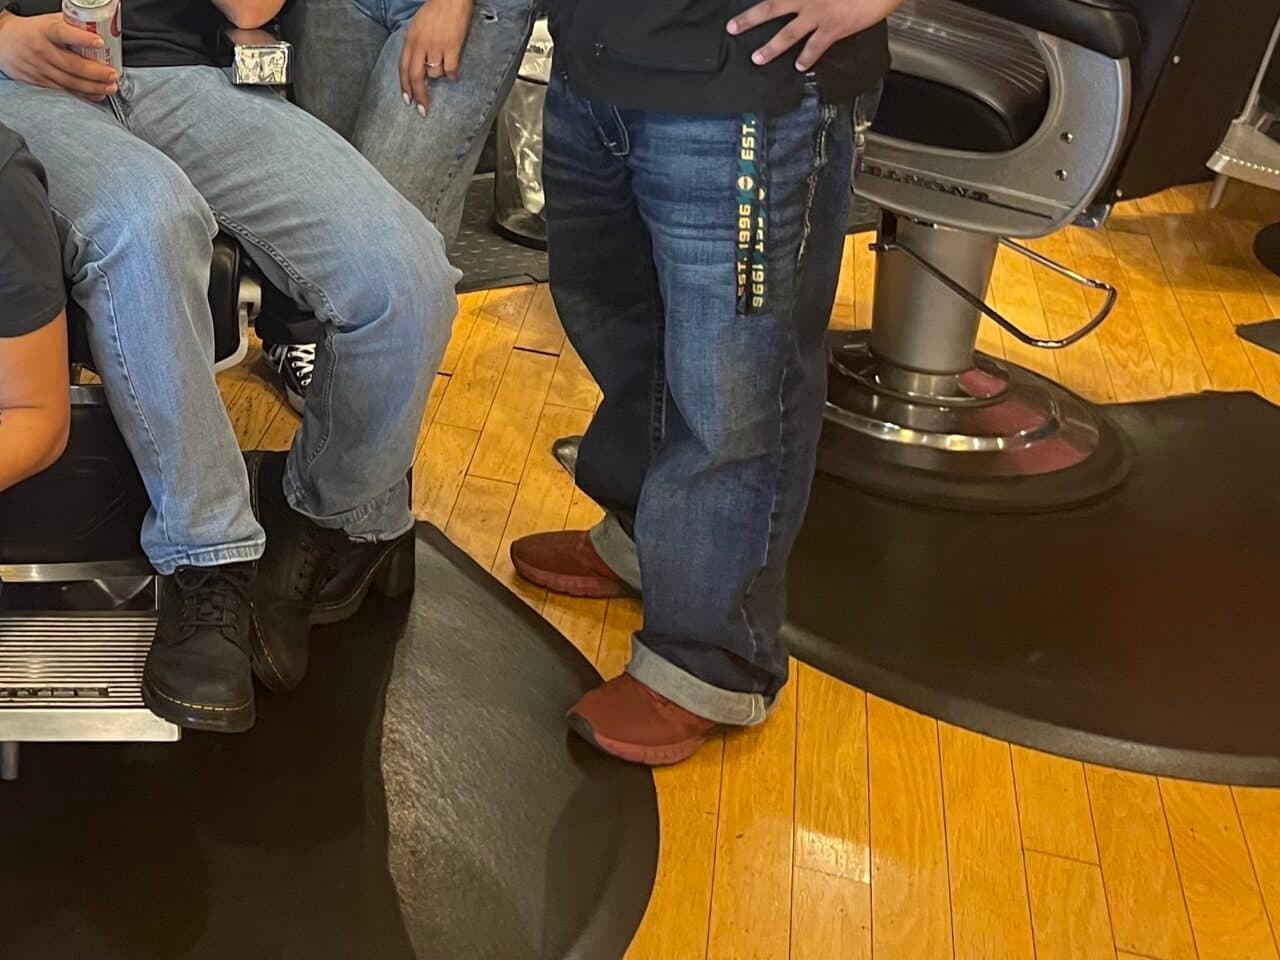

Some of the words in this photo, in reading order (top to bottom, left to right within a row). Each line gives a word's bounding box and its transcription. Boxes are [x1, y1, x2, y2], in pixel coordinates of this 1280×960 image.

[741, 119, 756, 161] EST.
[738, 204, 752, 249] 1996
[752, 263, 765, 308] 1996
